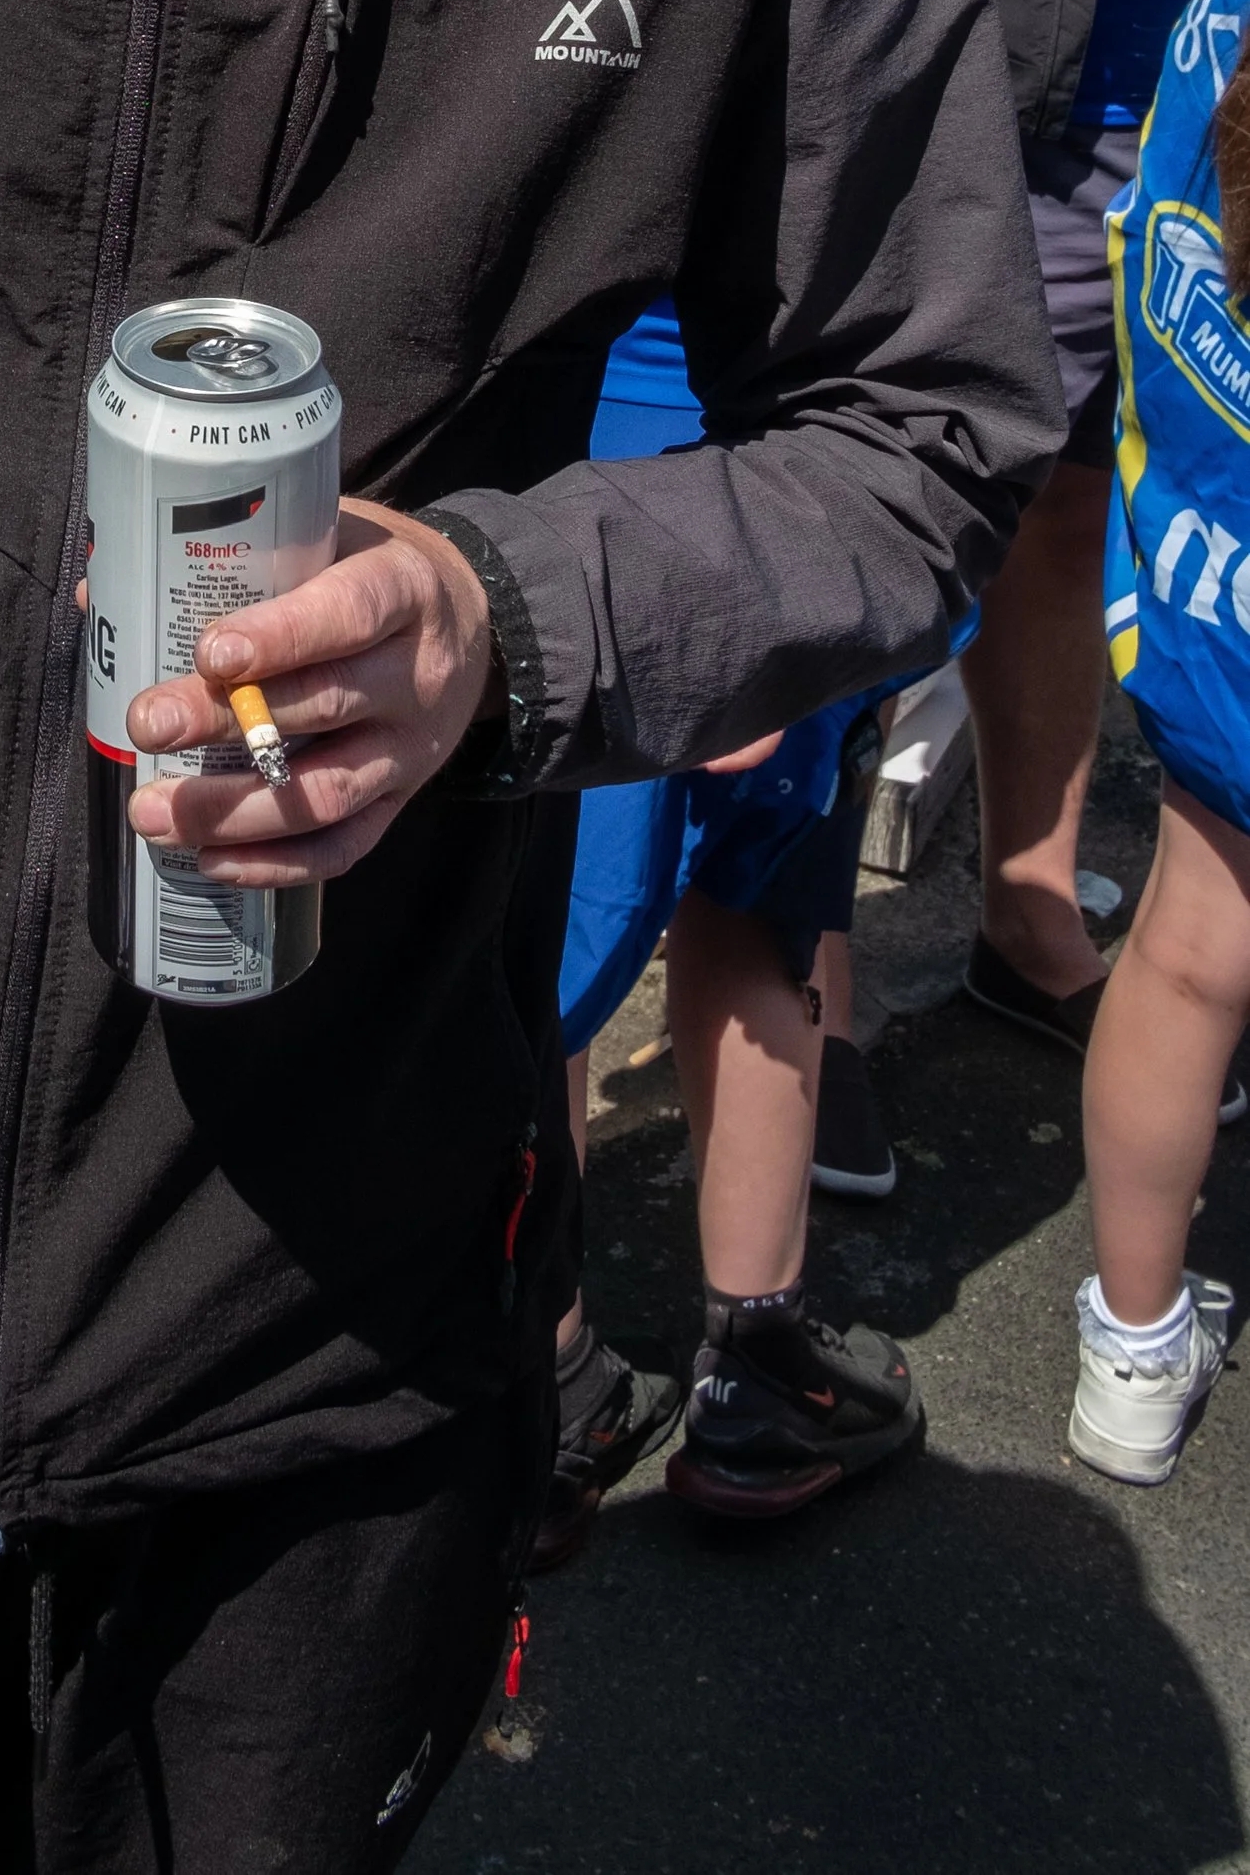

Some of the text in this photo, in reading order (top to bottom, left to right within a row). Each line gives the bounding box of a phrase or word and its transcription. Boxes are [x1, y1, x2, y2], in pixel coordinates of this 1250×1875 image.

[105, 390, 127, 417] CAN
[295, 384, 336, 430] PINT CAN
[190, 422, 271, 445] PINT CAN
[187, 582, 210, 590] Brewed
[241, 583, 248, 591] by
[196, 574, 218, 583] Carling
[230, 592, 244, 600] High
